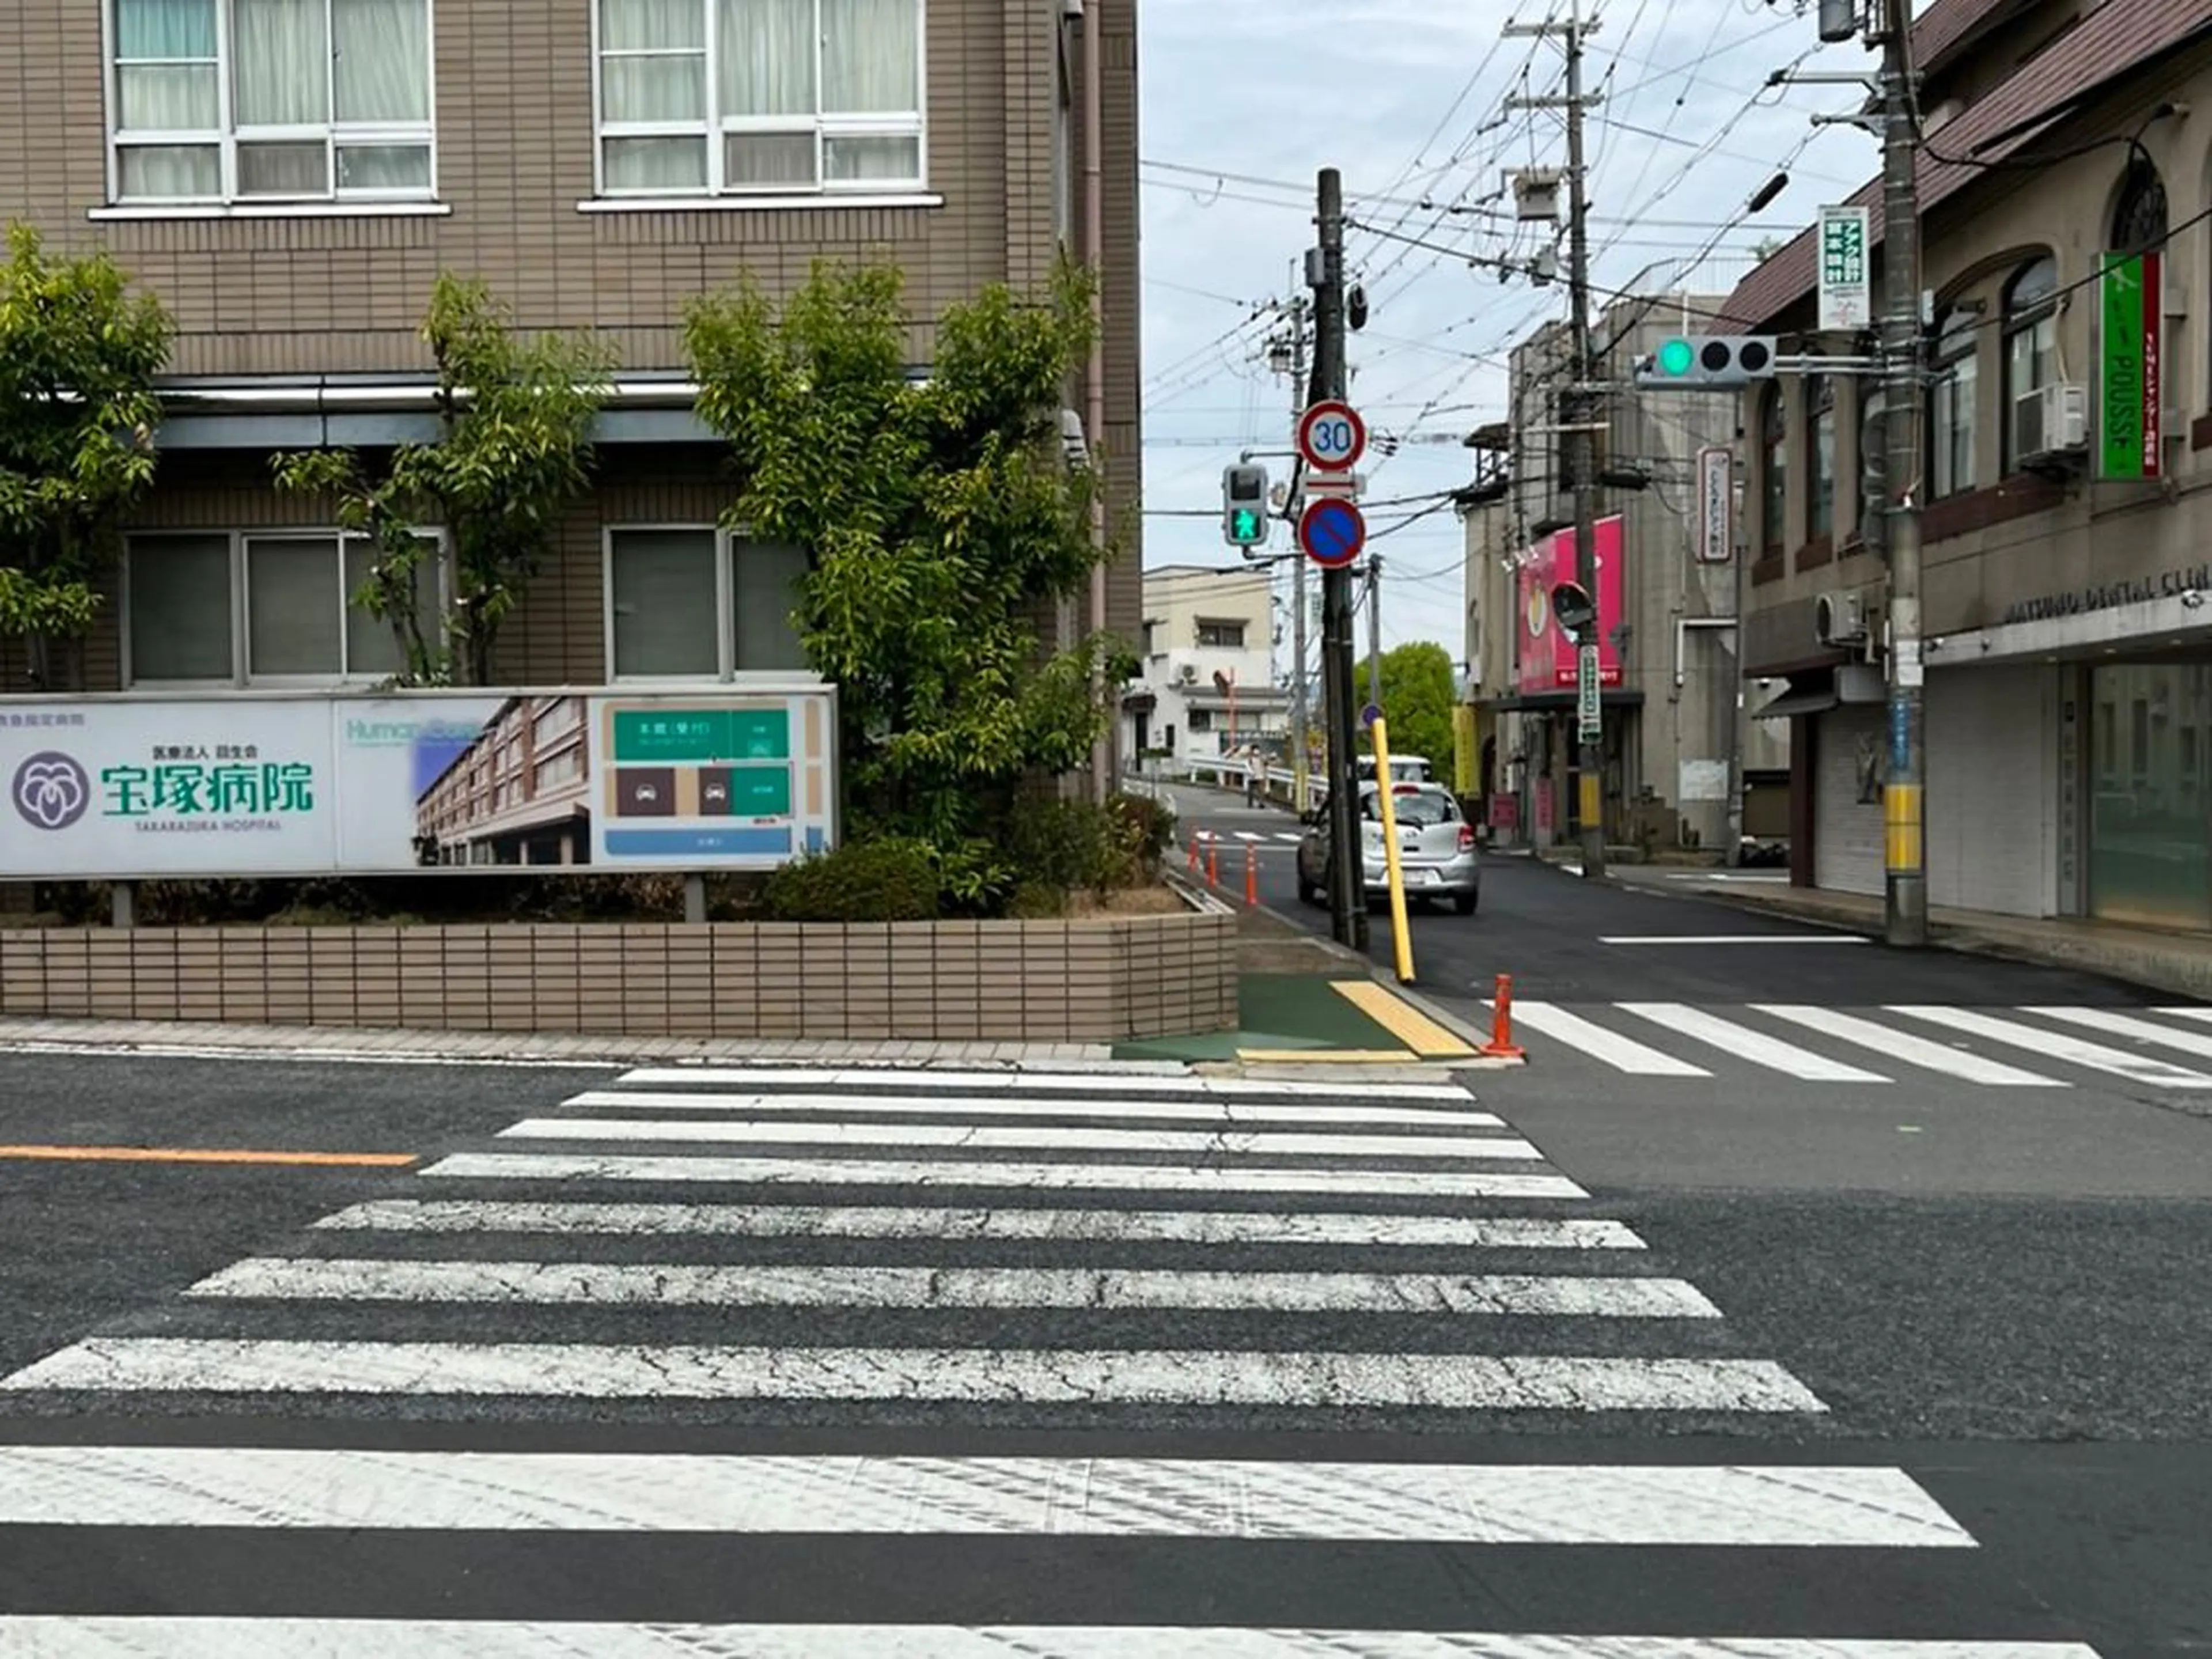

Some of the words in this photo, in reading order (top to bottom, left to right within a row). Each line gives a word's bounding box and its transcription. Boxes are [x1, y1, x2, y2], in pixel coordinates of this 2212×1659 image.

[1315, 422, 1351, 452] 30
[101, 762, 313, 816] 宝塚病院
[134, 820, 218, 832] TAKARAZUKA
[222, 819, 282, 832] HOSPITAL
